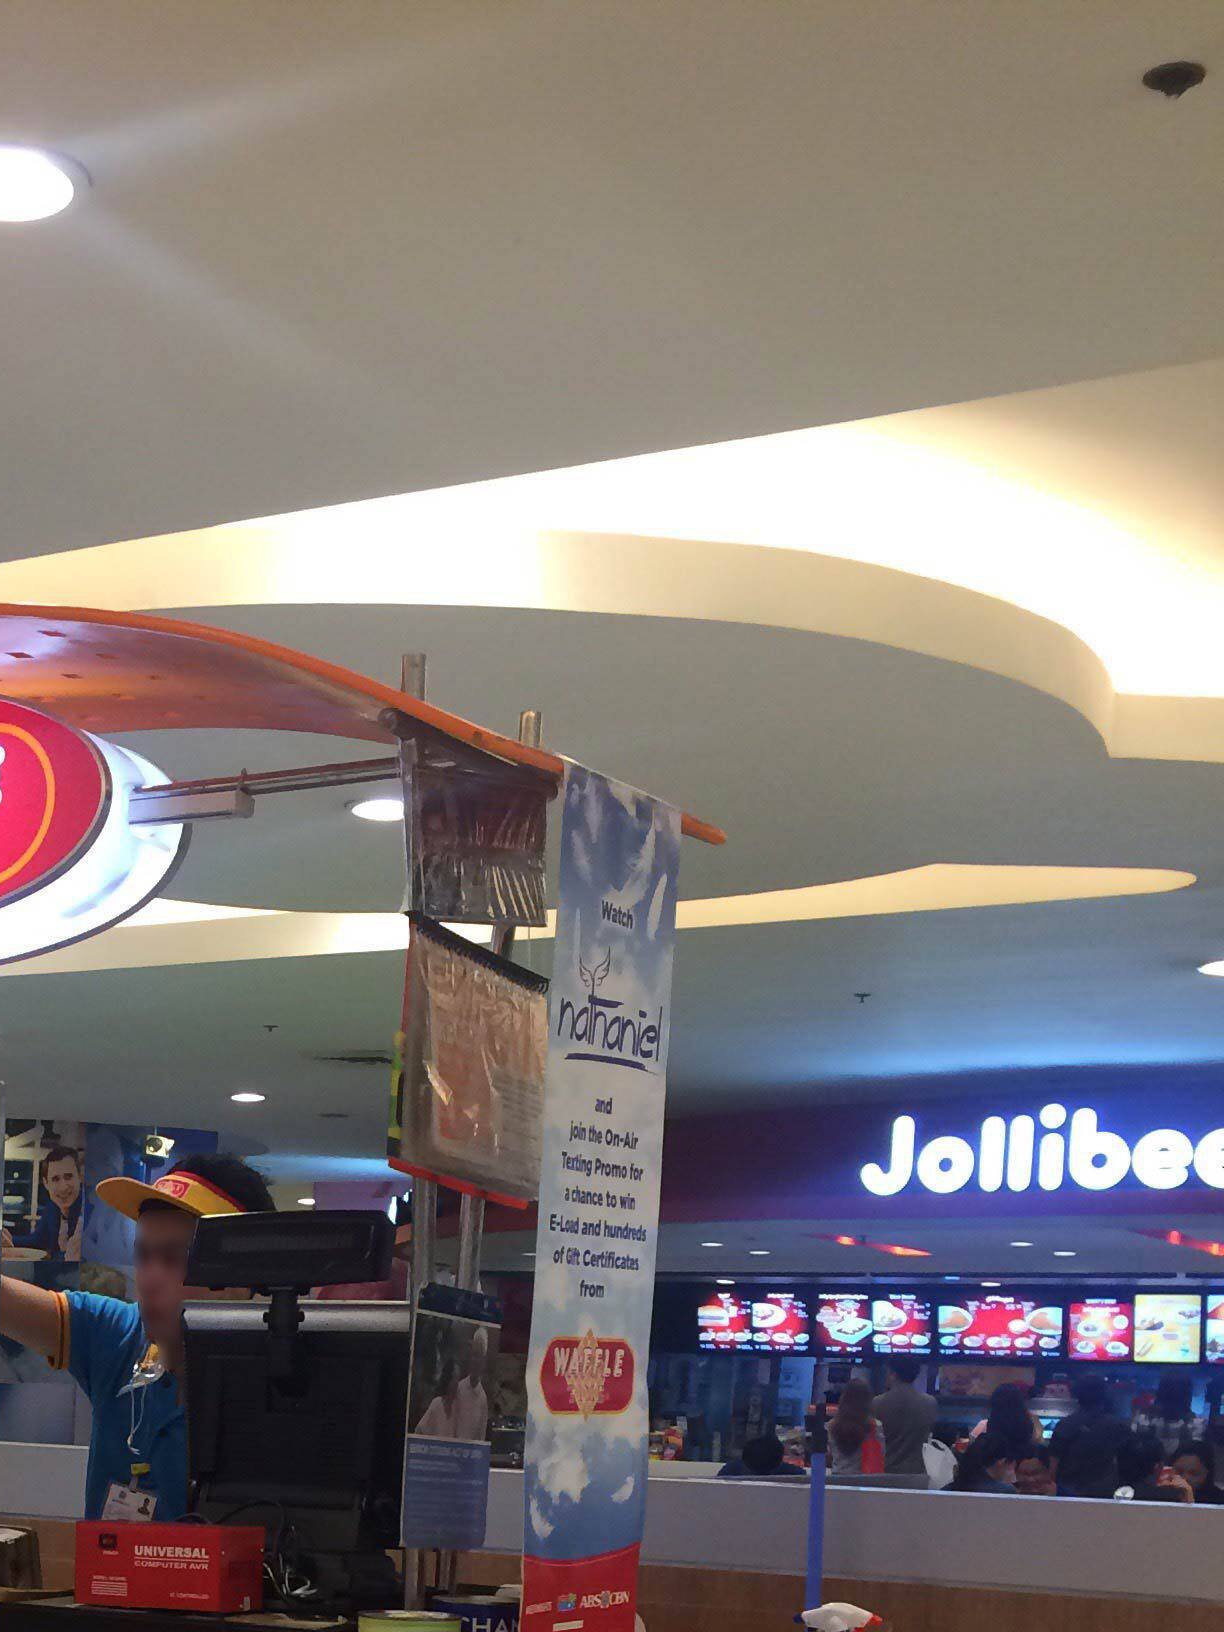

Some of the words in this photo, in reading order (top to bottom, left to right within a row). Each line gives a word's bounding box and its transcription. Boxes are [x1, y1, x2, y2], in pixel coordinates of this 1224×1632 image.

[601, 899, 634, 929] Watch
[557, 996, 663, 1062] nathaniel
[595, 1097, 613, 1115] and
[569, 1120, 587, 1142] join
[588, 1125, 603, 1145] the
[605, 1129, 639, 1150] On-Air
[561, 1151, 593, 1177] Texting
[594, 1158, 627, 1181] Promo
[629, 1163, 644, 1182] for
[564, 1186, 570, 1202] a
[571, 1186, 604, 1208] chance
[606, 1191, 617, 1209] to
[619, 1193, 636, 1210] win
[549, 1213, 580, 1235] E-Load
[581, 1220, 601, 1237] and
[603, 1219, 647, 1242] hundreds
[552, 1247, 566, 1264] of
[566, 1248, 580, 1266] Gift
[582, 1250, 640, 1271] Certificates
[579, 1279, 605, 1298] from
[554, 1347, 625, 1378] WAFFLE
[133, 1560, 187, 1569] COMPUTER
[134, 1545, 209, 1559] UNIVERSAL
